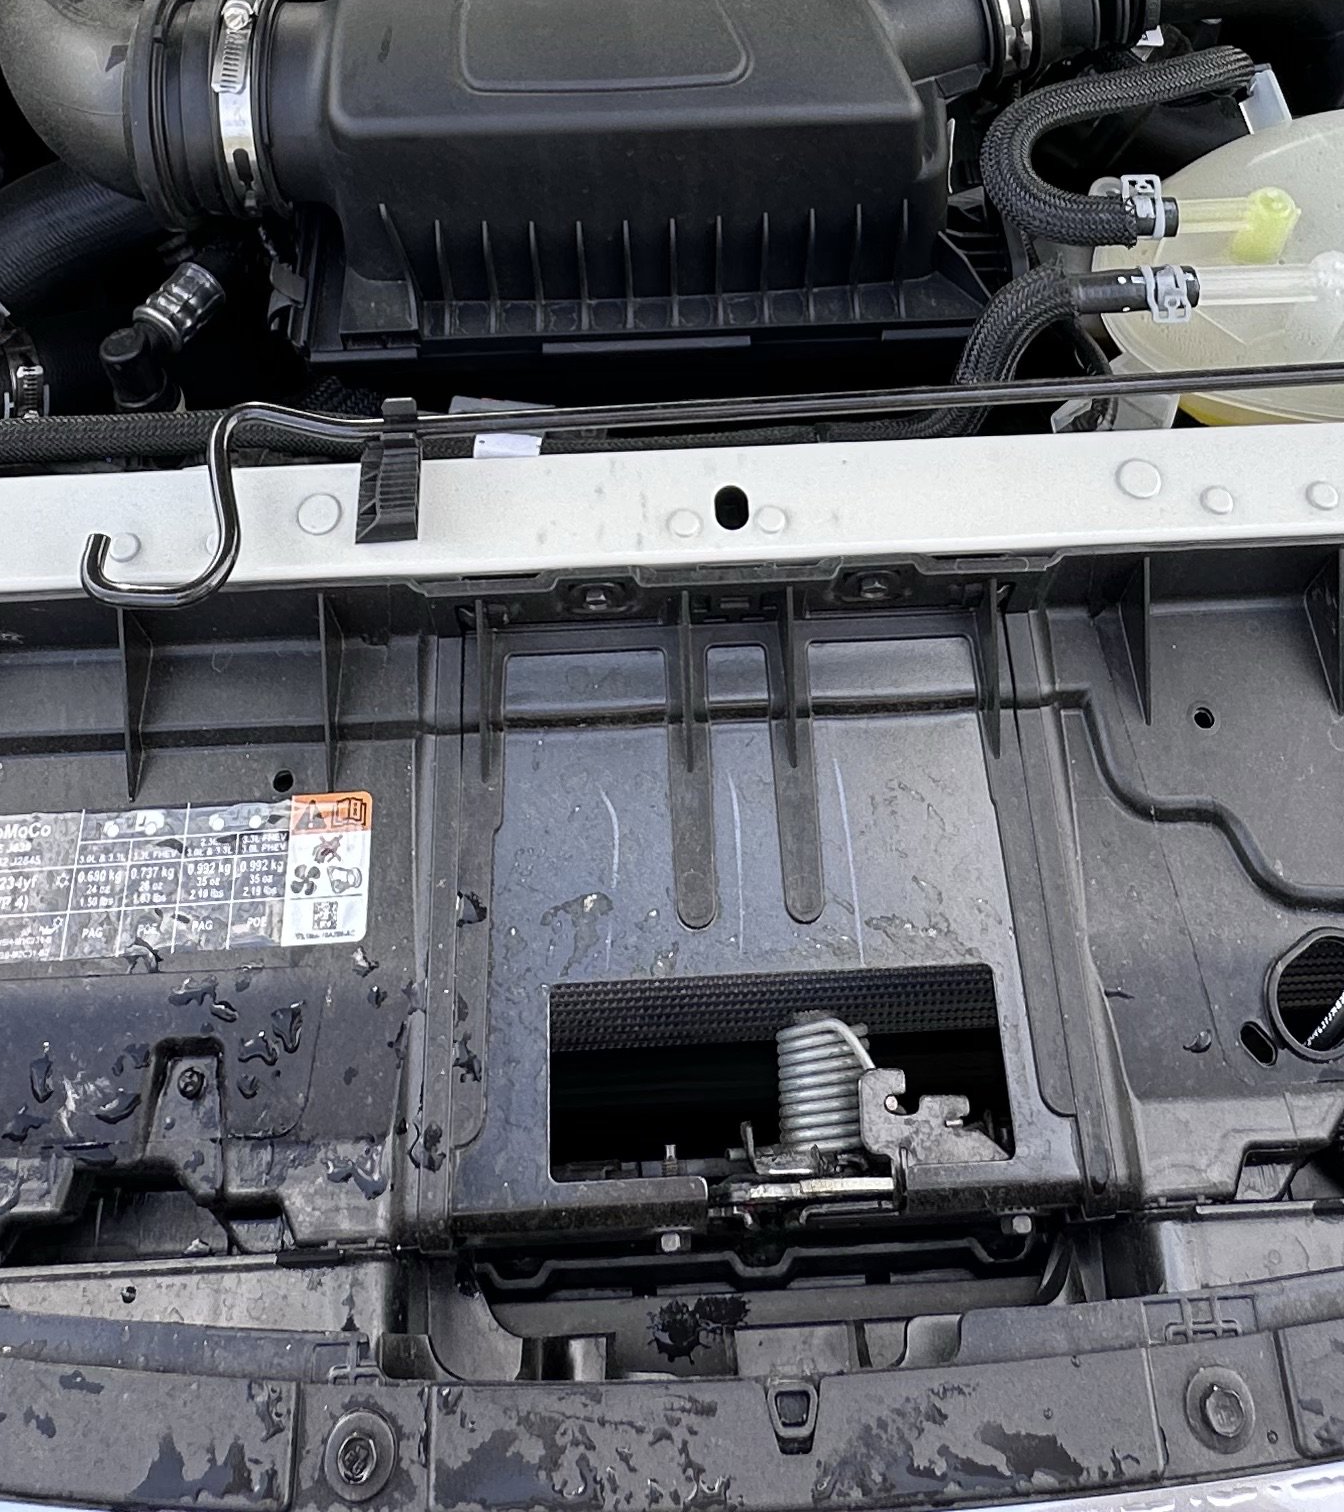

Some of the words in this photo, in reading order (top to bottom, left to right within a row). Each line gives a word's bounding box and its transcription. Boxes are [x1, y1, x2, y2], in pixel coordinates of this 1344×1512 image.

[187, 862, 215, 875] 0.992
[218, 860, 231, 875] kg
[240, 860, 269, 873] 0.992
[270, 858, 284, 872] kg
[109, 869, 123, 884] kg
[130, 867, 159, 879] 0.737
[161, 866, 175, 880] kg
[196, 877, 207, 886] 35
[249, 875, 260, 884] 35
[86, 885, 97, 895] 24
[152, 882, 164, 890] oz
[14, 895, 29, 911] 4)
[191, 920, 214, 932] PAG
[246, 916, 268, 928] POE
[81, 928, 103, 938] PAG
